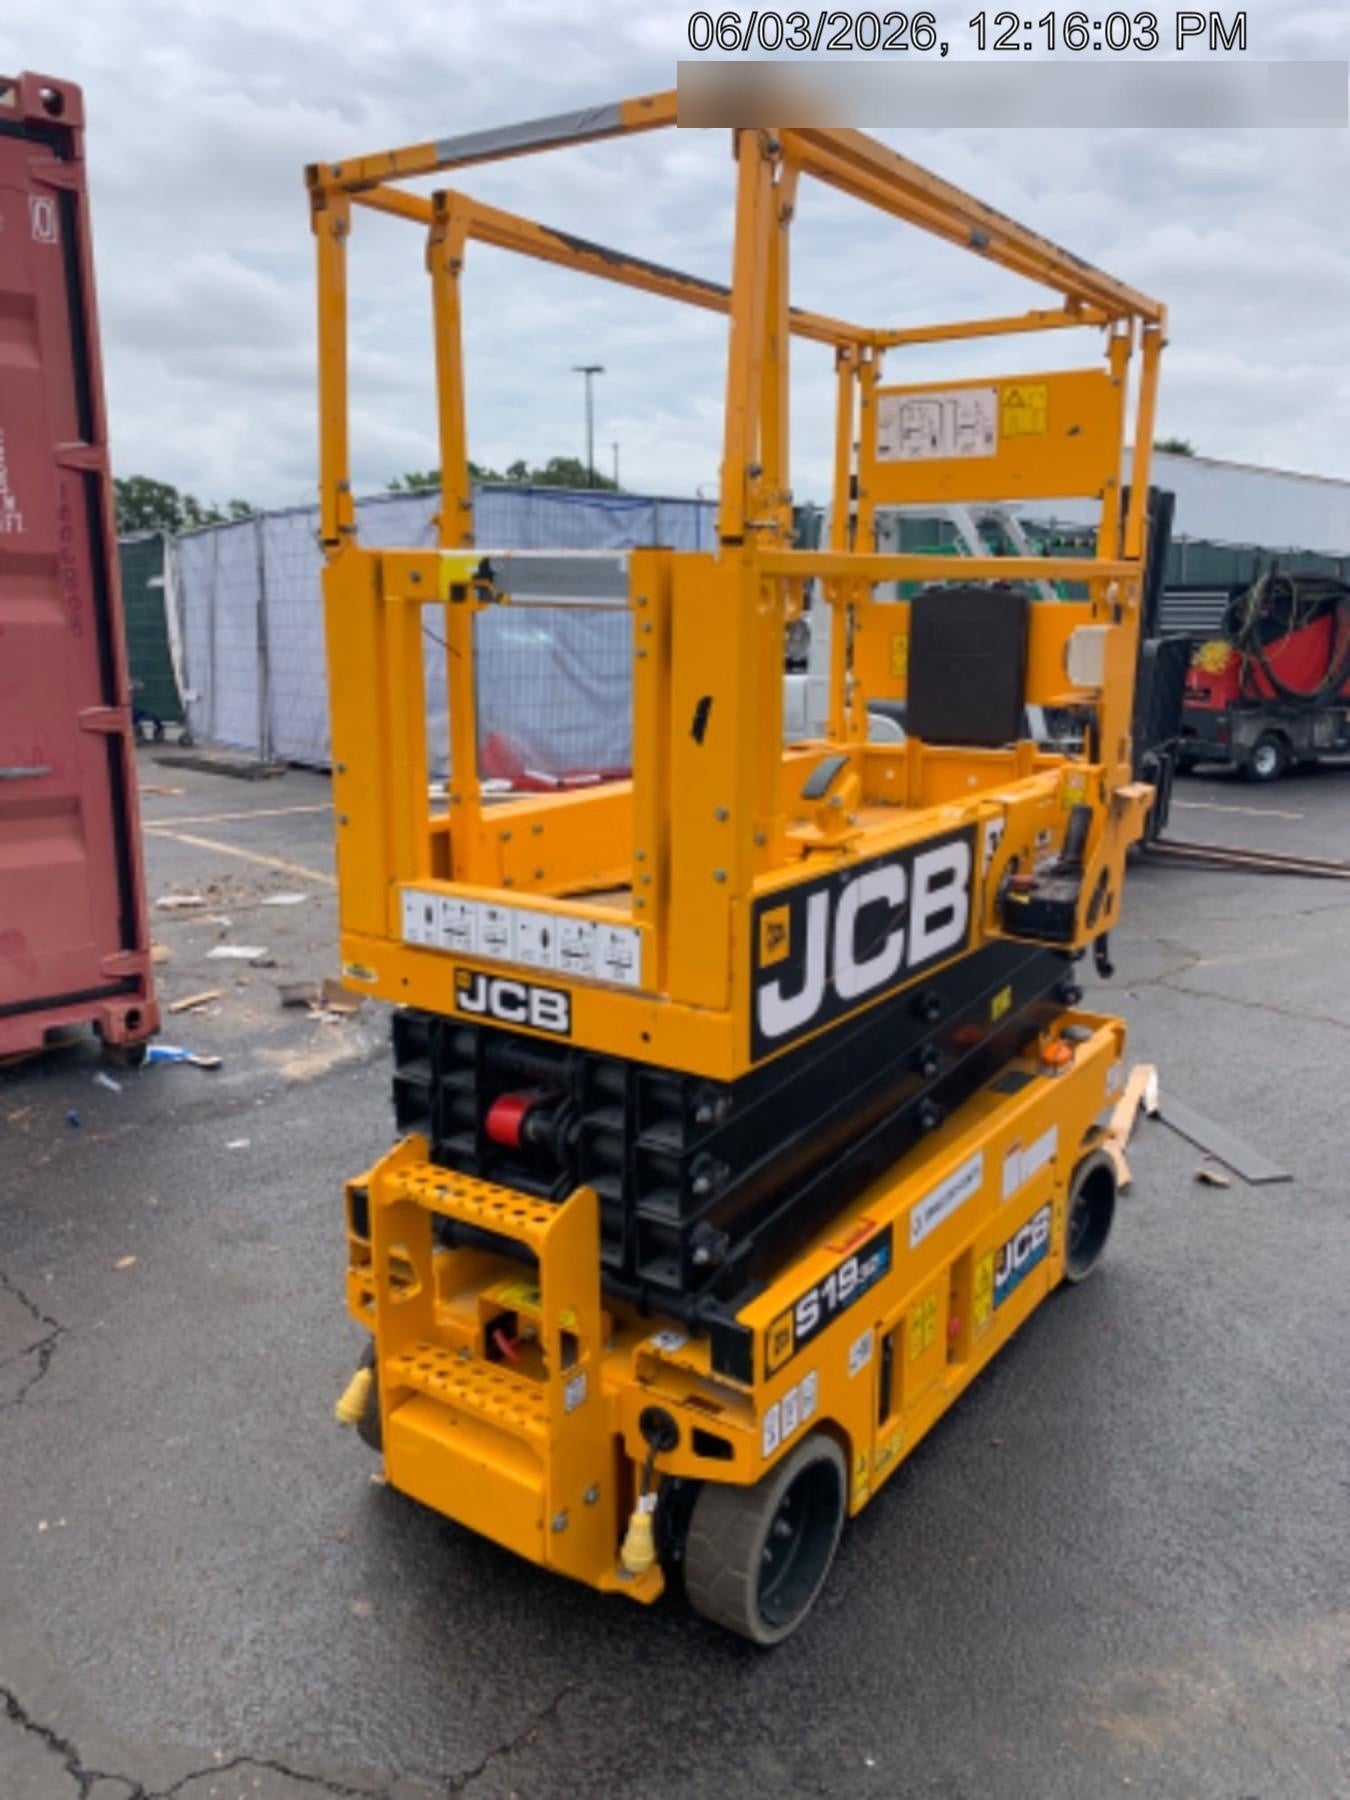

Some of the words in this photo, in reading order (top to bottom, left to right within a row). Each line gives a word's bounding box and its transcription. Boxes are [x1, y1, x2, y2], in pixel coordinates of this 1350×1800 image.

[757, 841, 971, 1039] JCB
[457, 974, 569, 1032] JCB
[995, 1206, 1051, 1286] JCB
